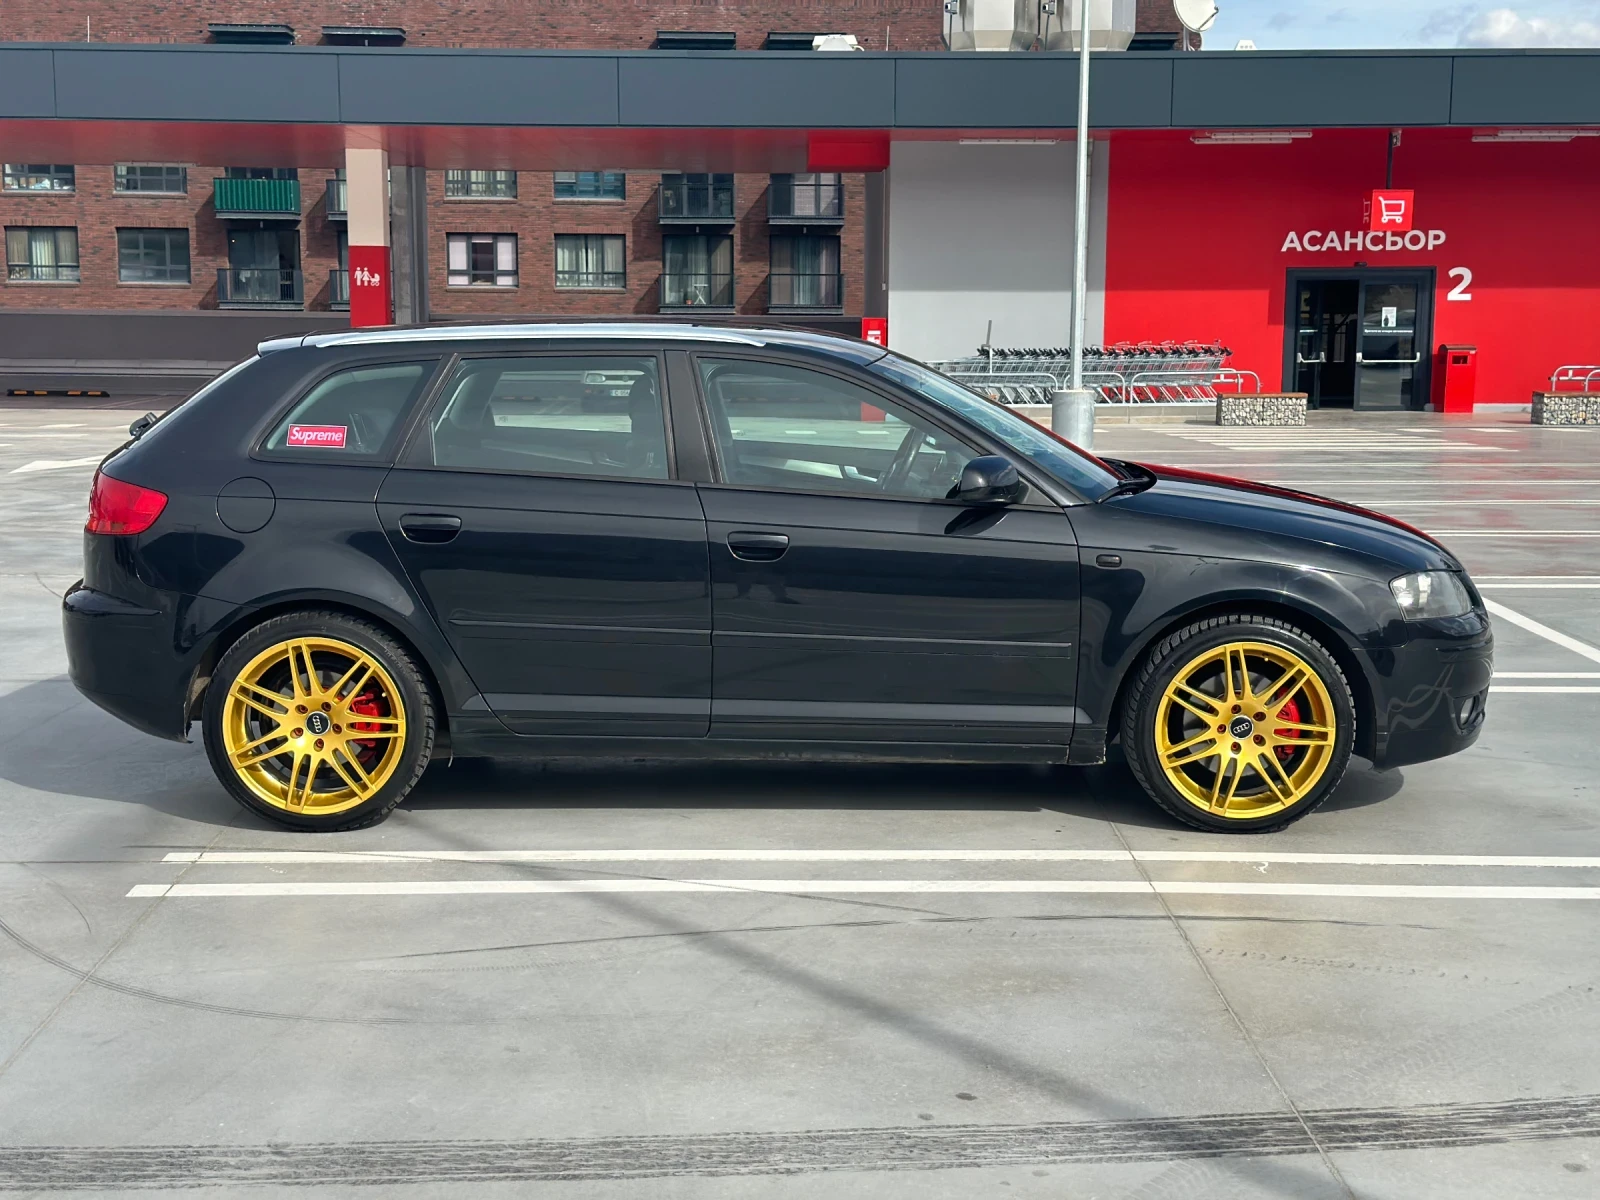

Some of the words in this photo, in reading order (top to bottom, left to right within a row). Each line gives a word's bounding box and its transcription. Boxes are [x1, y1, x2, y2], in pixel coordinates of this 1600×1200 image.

[1281, 229, 1447, 252] АСАНСЬОР
[1446, 266, 1473, 301] 2
[290, 427, 343, 444] Supreme
